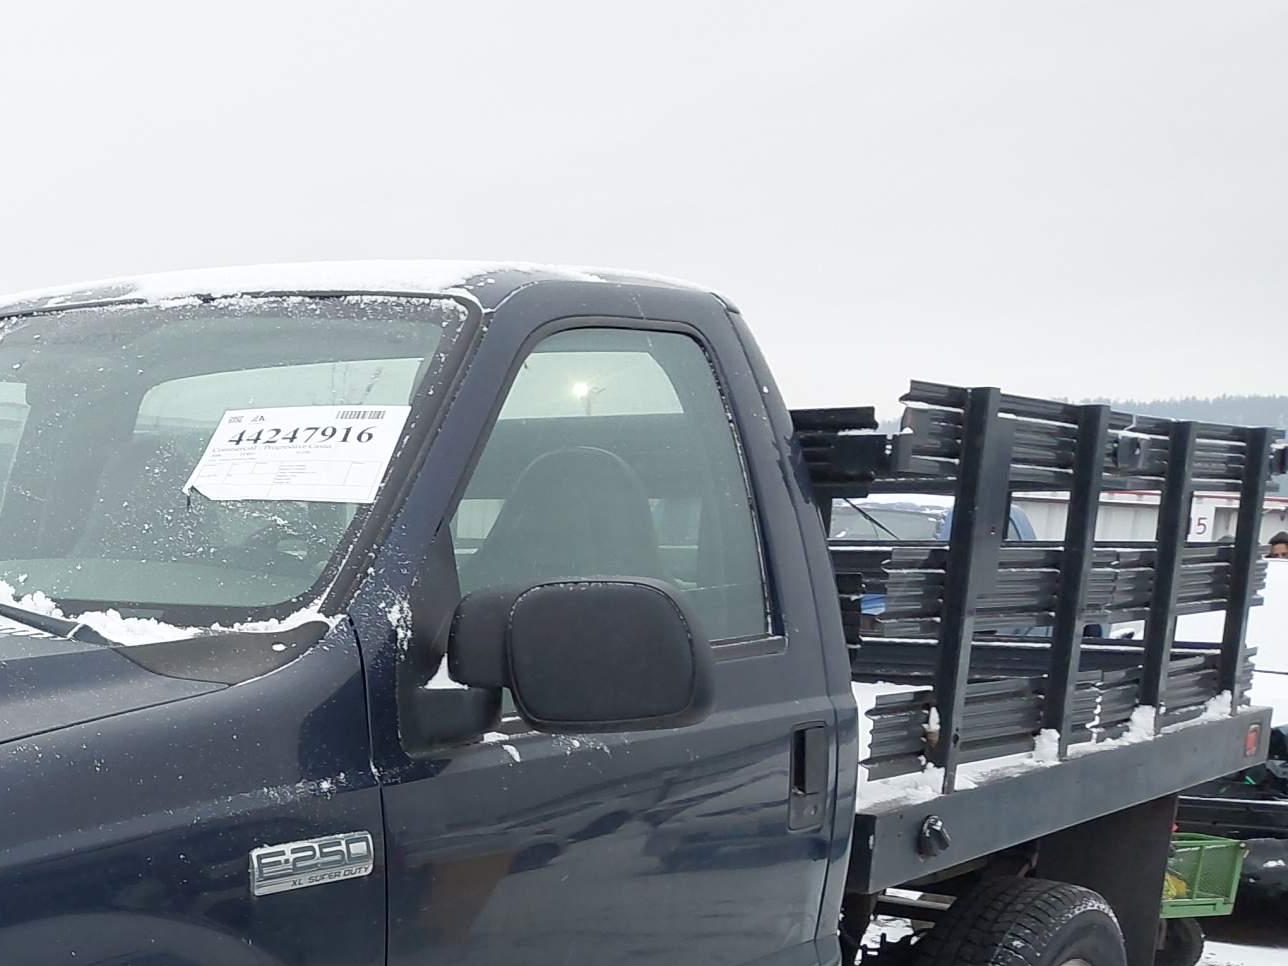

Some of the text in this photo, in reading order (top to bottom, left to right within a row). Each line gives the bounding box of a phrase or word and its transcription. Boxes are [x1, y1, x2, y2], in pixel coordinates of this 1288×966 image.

[228, 426, 375, 445] 44247916
[256, 836, 371, 881] F-250
[290, 866, 370, 888] XL SUPER DUTY
